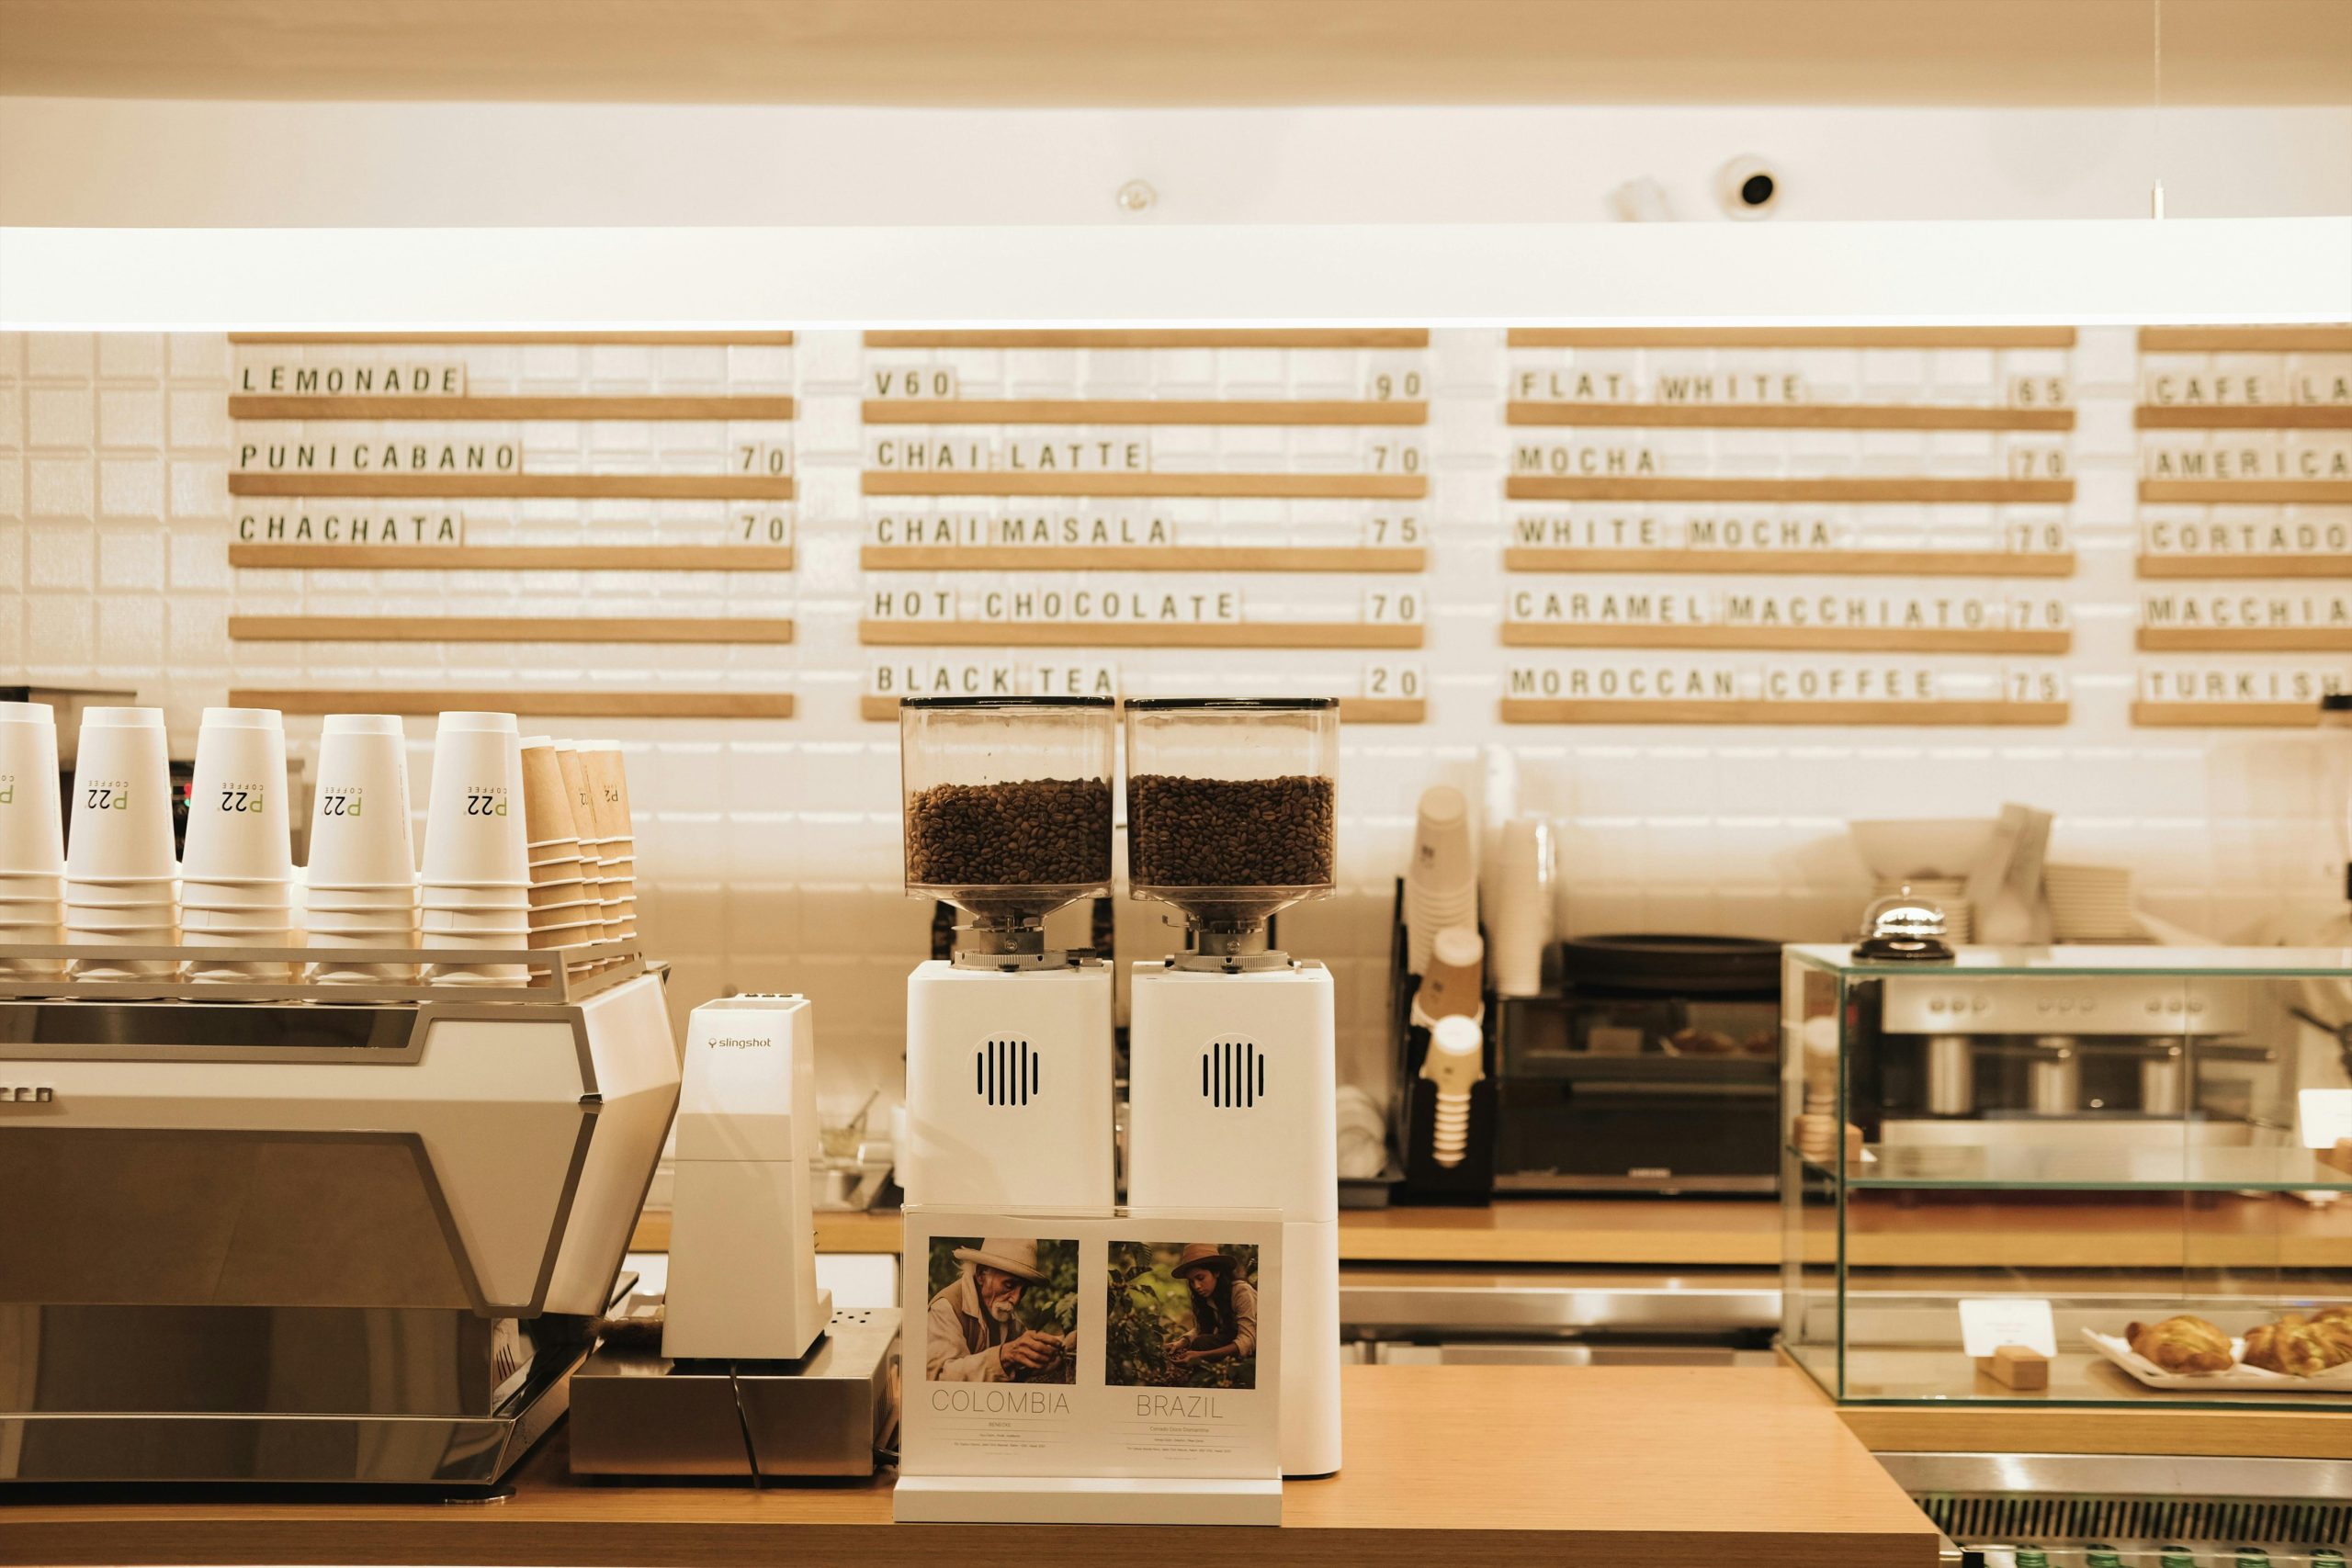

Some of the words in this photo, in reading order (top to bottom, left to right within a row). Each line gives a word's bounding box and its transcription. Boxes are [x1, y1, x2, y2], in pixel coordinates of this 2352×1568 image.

[243, 367, 459, 393] LEMONADE
[876, 371, 948, 396] V60
[1375, 371, 1421, 400] 90
[1521, 374, 1623, 398] FLAT
[1660, 374, 1802, 401] WHITE
[2018, 380, 2066, 403] 65
[2156, 378, 2261, 403] CAFE
[240, 445, 514, 471] PUNICABANO
[740, 445, 786, 474] 70
[876, 443, 978, 470] CHAI
[1011, 443, 1141, 471] LATTE
[1372, 446, 1419, 473] 70
[1519, 448, 1655, 475] MOCHA
[2019, 449, 2066, 476] 70
[2156, 454, 2349, 479] AMERICA
[239, 516, 456, 542] CHACHATA
[740, 516, 786, 543] 70
[876, 518, 978, 544] CHAI
[1001, 518, 1166, 544] MASALA
[1372, 518, 1419, 544] 75
[1519, 518, 1656, 545] WHITE
[1690, 520, 1831, 547] MOCHA
[2152, 525, 2347, 550] CORTADO
[875, 592, 950, 618] HOT
[985, 592, 1234, 620] CHOCOLATE
[1371, 594, 1416, 621] 70
[1514, 592, 1702, 620] CARAMEL
[1728, 597, 1983, 626] MACCHIATO
[2013, 599, 2064, 626] 70
[2148, 600, 2350, 626] MACCHIA
[877, 667, 1009, 692] BLACK
[1038, 667, 1112, 694] TEA
[1370, 667, 1417, 695] 20
[1512, 671, 1734, 697] MOROCCAN
[1769, 672, 1931, 698] COFFEE
[2012, 674, 2060, 700] 75
[2149, 673, 2340, 699] TURKISH
[87, 789, 128, 809] P22
[222, 783, 264, 791] COFFEE
[221, 792, 263, 813] P22
[323, 796, 361, 817] P22
[468, 795, 507, 817] P22
[719, 1038, 771, 1049] slingshot
[931, 1389, 1070, 1415] COLOMBIA
[1136, 1394, 1224, 1419] BRAZIL
